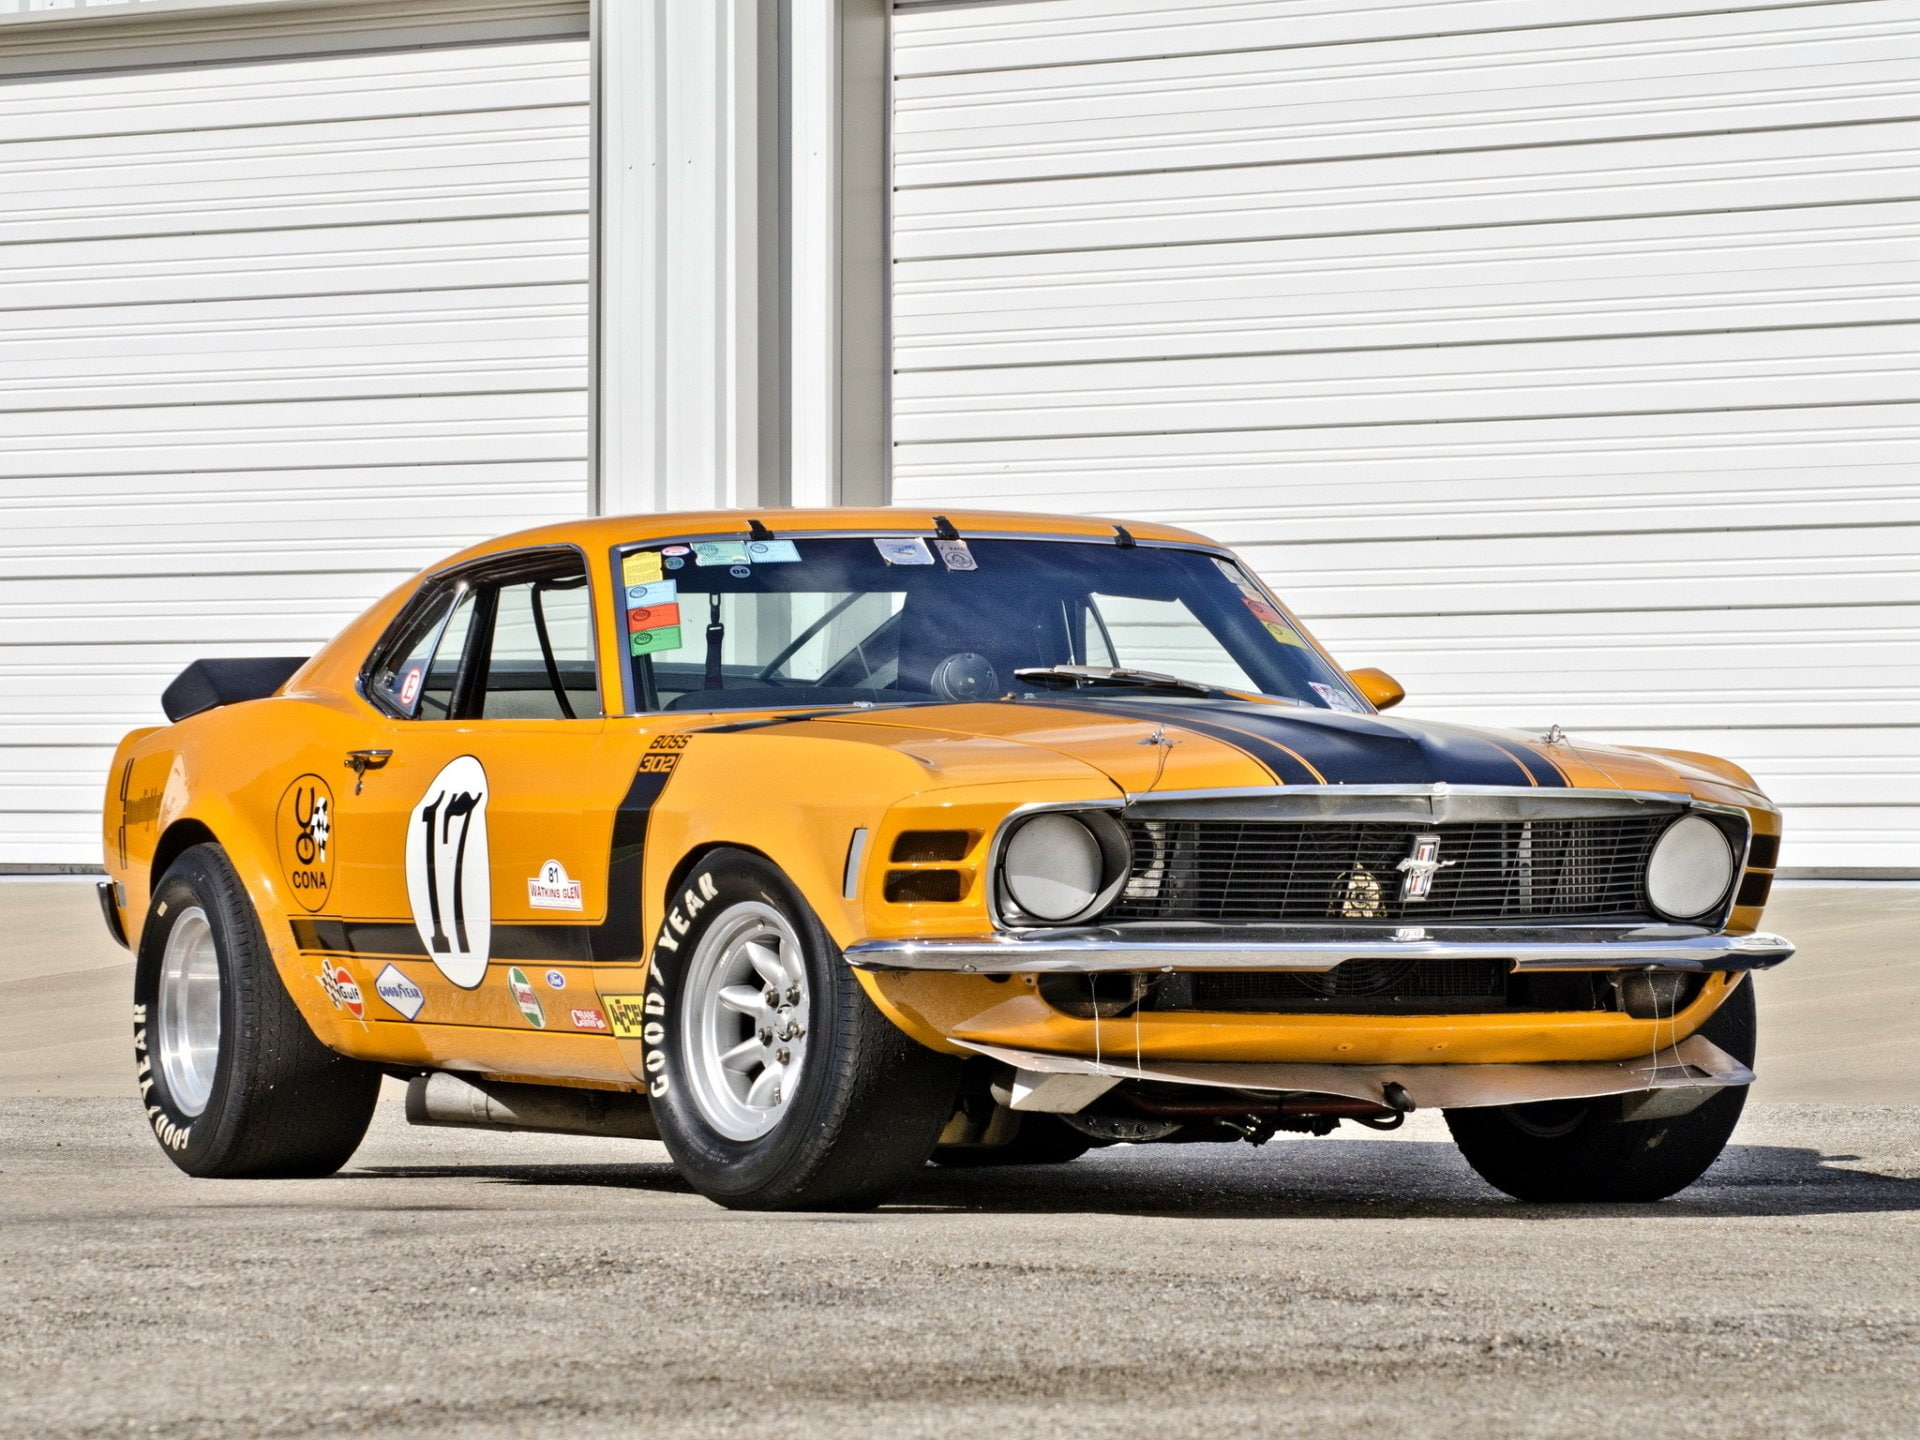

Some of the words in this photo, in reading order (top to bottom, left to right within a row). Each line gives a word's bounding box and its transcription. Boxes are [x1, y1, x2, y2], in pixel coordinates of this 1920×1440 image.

[648, 734, 693, 749] BOSS
[638, 755, 677, 773] 302
[292, 870, 328, 889] CONA
[422, 790, 483, 953] 17
[548, 866, 559, 883] 81
[530, 884, 561, 899] WATKINS
[562, 886, 580, 899] GLEN
[339, 985, 360, 1000] Gulf
[378, 983, 422, 1000] GOODYEAR
[609, 998, 643, 1033] ACCE
